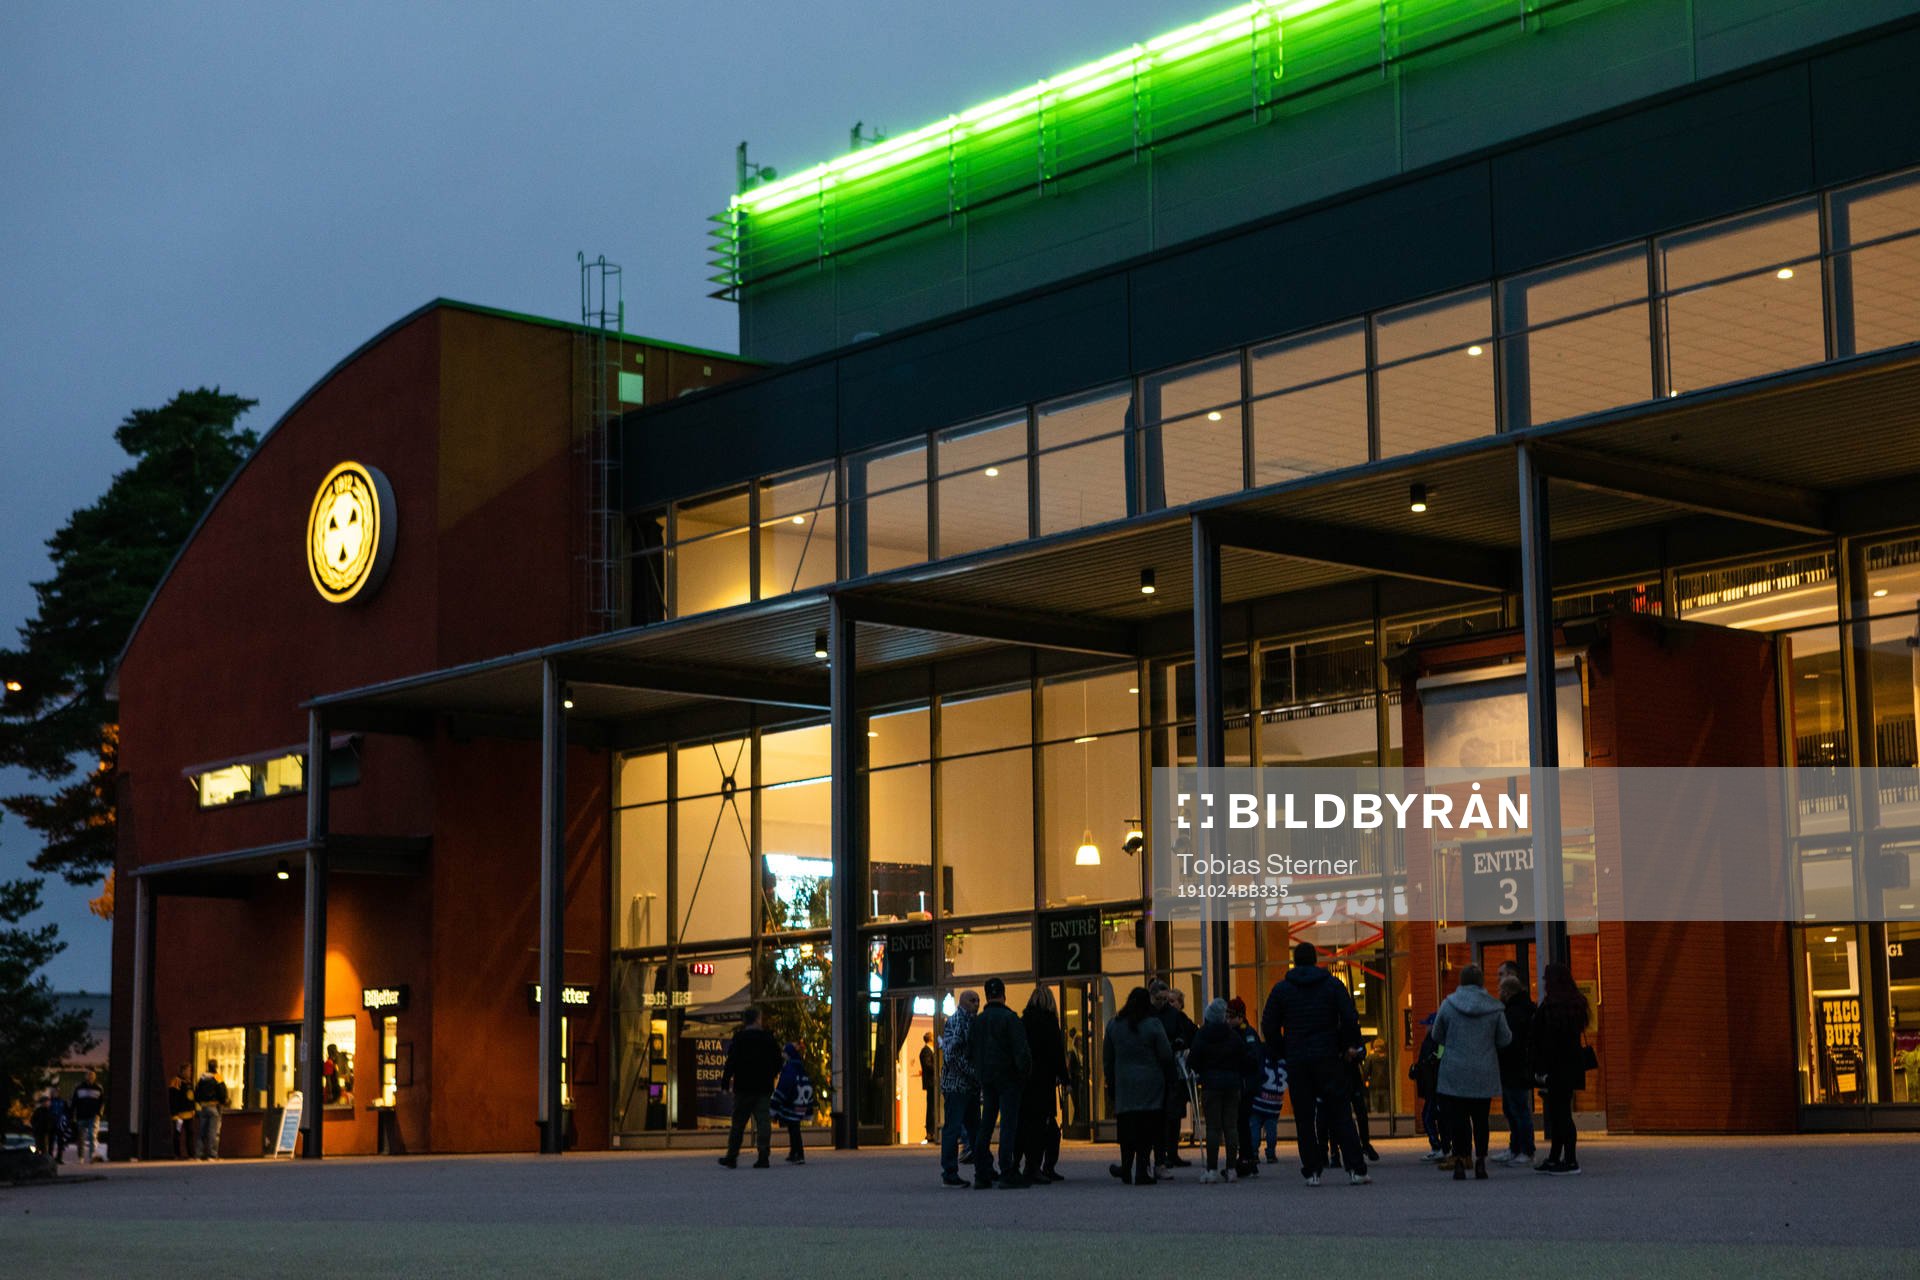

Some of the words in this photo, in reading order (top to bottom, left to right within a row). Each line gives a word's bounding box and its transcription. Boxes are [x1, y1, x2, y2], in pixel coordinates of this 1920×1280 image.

[1473, 847, 1534, 875] ENTR
[1498, 878, 1519, 915] 3
[1050, 916, 1098, 938] ENTRÉ
[907, 956, 917, 983] 1
[1066, 942, 1081, 971] 2
[1823, 1000, 1860, 1023] TACO
[696, 1039, 723, 1051] ARTA
[1824, 1023, 1861, 1046] BUFF
[1261, 1065, 1289, 1092] 23
